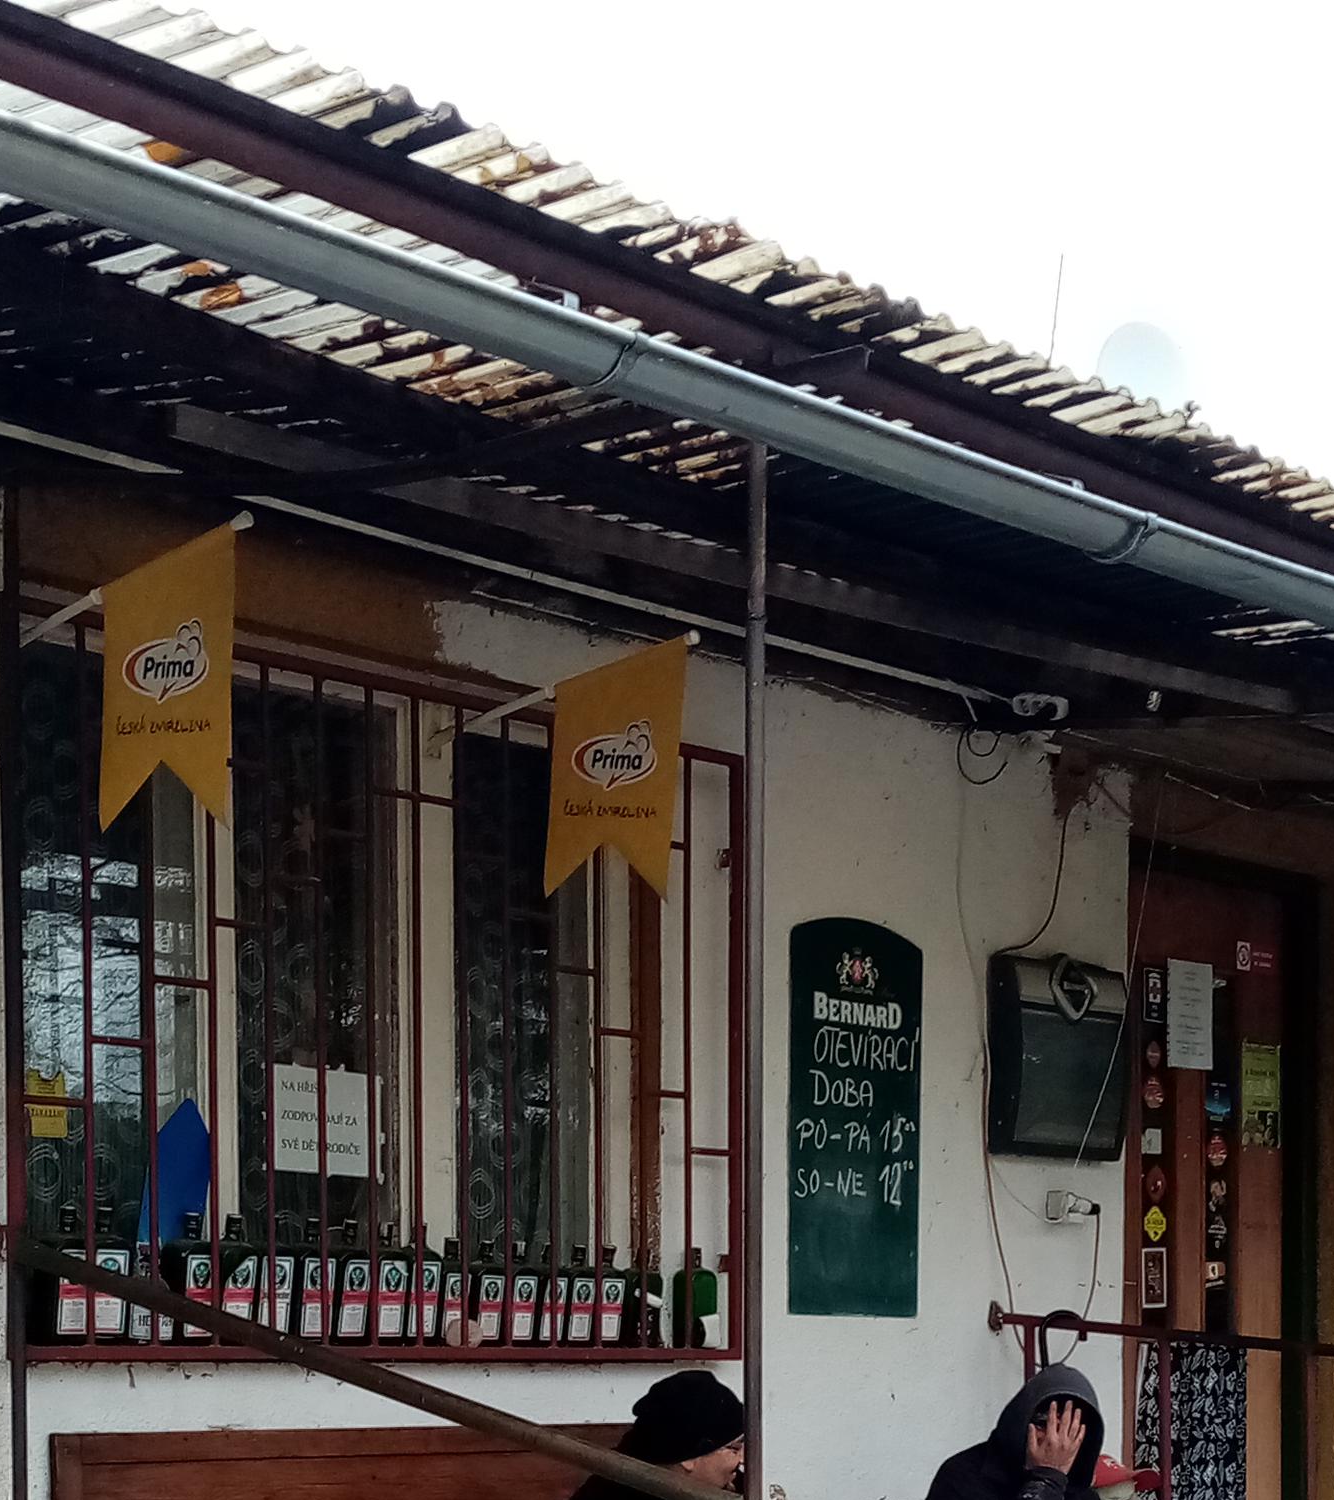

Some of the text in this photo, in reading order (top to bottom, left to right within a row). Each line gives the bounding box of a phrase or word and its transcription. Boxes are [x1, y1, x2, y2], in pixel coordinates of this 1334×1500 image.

[142, 654, 195, 680] Prima
[591, 747, 643, 770] Prima
[813, 990, 903, 1030] BERNARD
[813, 1025, 921, 1072] OTEVÍRACÍ
[281, 1080, 296, 1092] NA
[808, 1068, 874, 1108] DOBA
[345, 1115, 357, 1126] ZA
[281, 1137, 299, 1150] SVÉ
